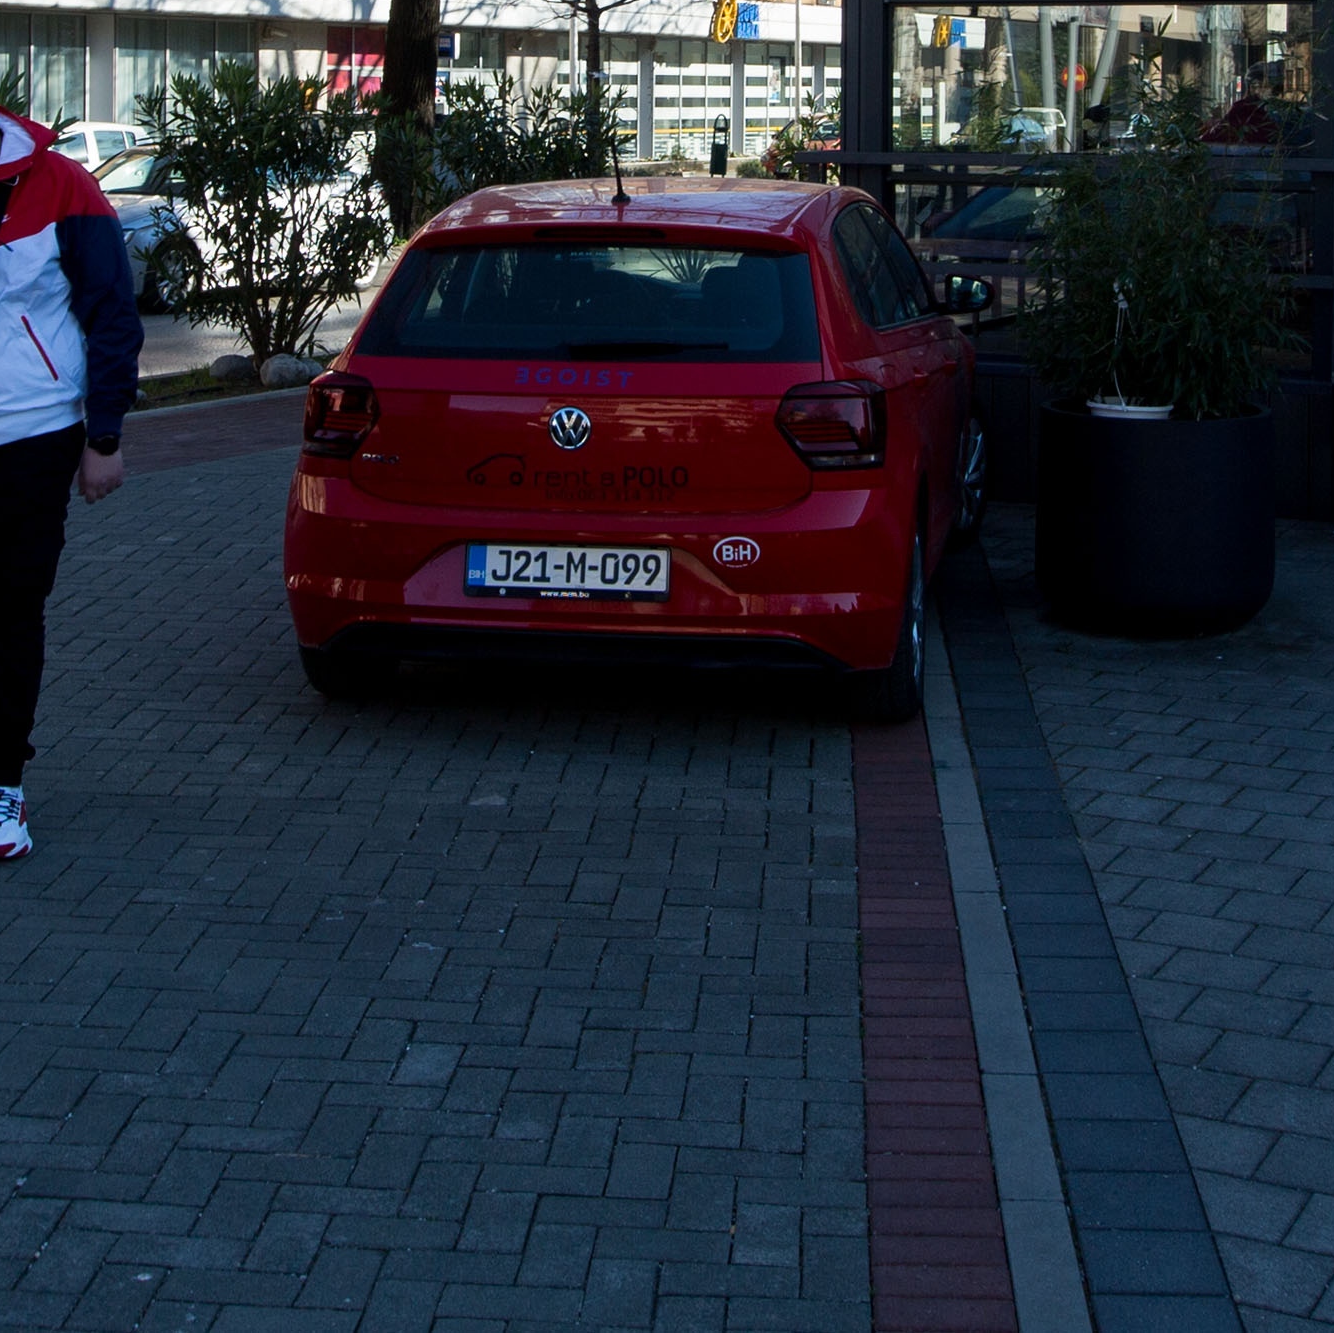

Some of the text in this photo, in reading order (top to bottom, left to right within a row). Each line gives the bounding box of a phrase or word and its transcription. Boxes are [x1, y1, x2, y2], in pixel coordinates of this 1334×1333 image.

[534, 466, 688, 488] rent a POLO
[722, 544, 751, 561] BiH
[491, 549, 661, 585] J21-M-099
